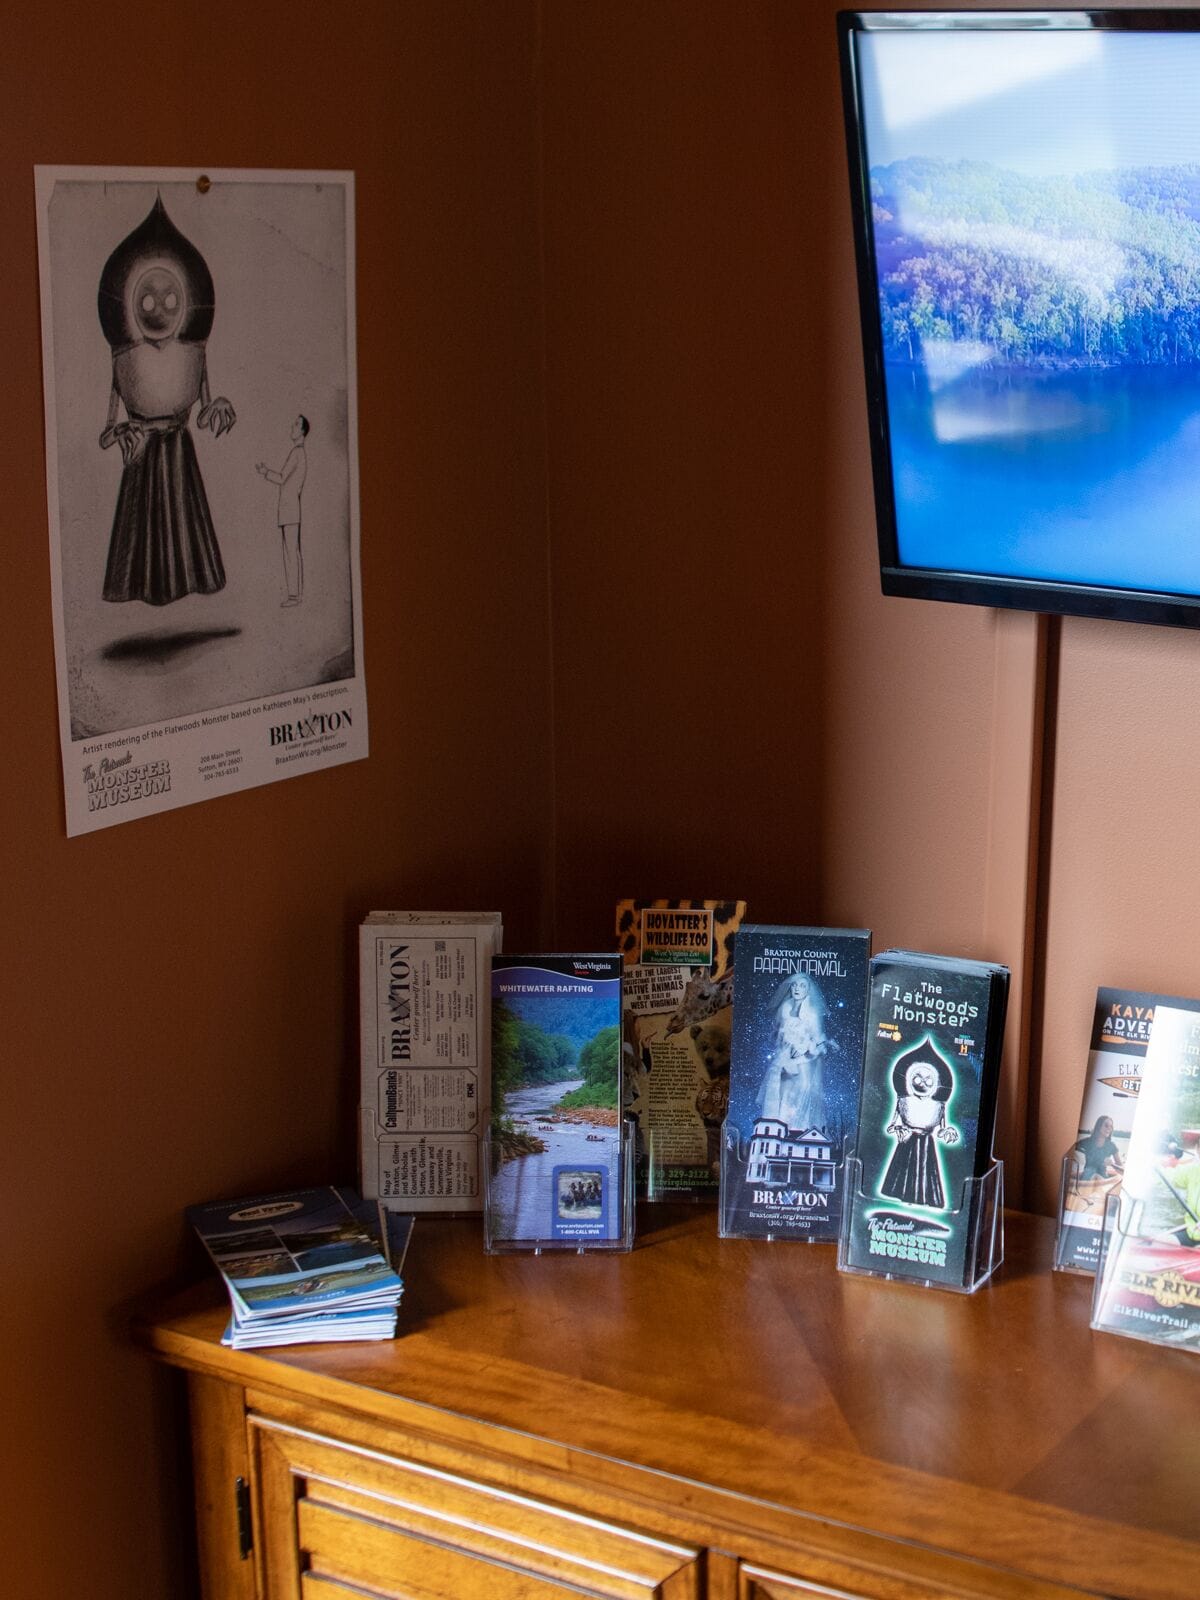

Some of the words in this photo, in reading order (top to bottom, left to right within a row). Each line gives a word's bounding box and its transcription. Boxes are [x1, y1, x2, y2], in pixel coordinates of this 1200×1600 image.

[82, 743, 103, 755] Artist
[104, 735, 141, 749] rendering
[141, 731, 150, 740] of
[151, 728, 163, 738] the
[164, 719, 201, 735] Flatwoods
[201, 714, 230, 727] Monster
[230, 708, 251, 720] based
[252, 704, 262, 713] on
[262, 700, 292, 713] Kathleen
[312, 686, 350, 701] description.
[268, 707, 353, 747] BRAXTON
[87, 758, 171, 793] MONSTER
[88, 774, 171, 812] MUSEUM
[646, 913, 708, 930] HOVATTER'S
[646, 932, 688, 946] WILDLIFE
[690, 932, 708, 947] ZOO
[764, 948, 801, 957] BRAXTON
[803, 949, 839, 959] COUNTY
[645, 968, 654, 977] THE
[656, 966, 681, 975] LARGEST
[753, 956, 847, 977] PARANORMAL
[500, 985, 555, 993] WHITEWATER
[556, 985, 594, 993] RAFTING
[624, 983, 650, 995] NATIVE
[651, 980, 684, 993] ANIMALS
[921, 982, 943, 994] The
[388, 944, 411, 1060] BRAXTON
[631, 1000, 648, 1010] WEST
[649, 997, 680, 1009] VIRGINIA!
[881, 983, 979, 1018] Flatwoods
[893, 1005, 969, 1028] Monster
[1119, 1064, 1140, 1075] ELK
[446, 1149, 454, 1176] Virginia
[384, 1170, 391, 1178] of
[428, 1161, 436, 1195] Gassaway
[384, 1180, 392, 1195] Map
[753, 1189, 829, 1207] BRAXTON
[871, 1229, 947, 1253] MONSTER
[869, 1240, 946, 1267] MUSEUM
[1120, 1271, 1158, 1290] ELK
